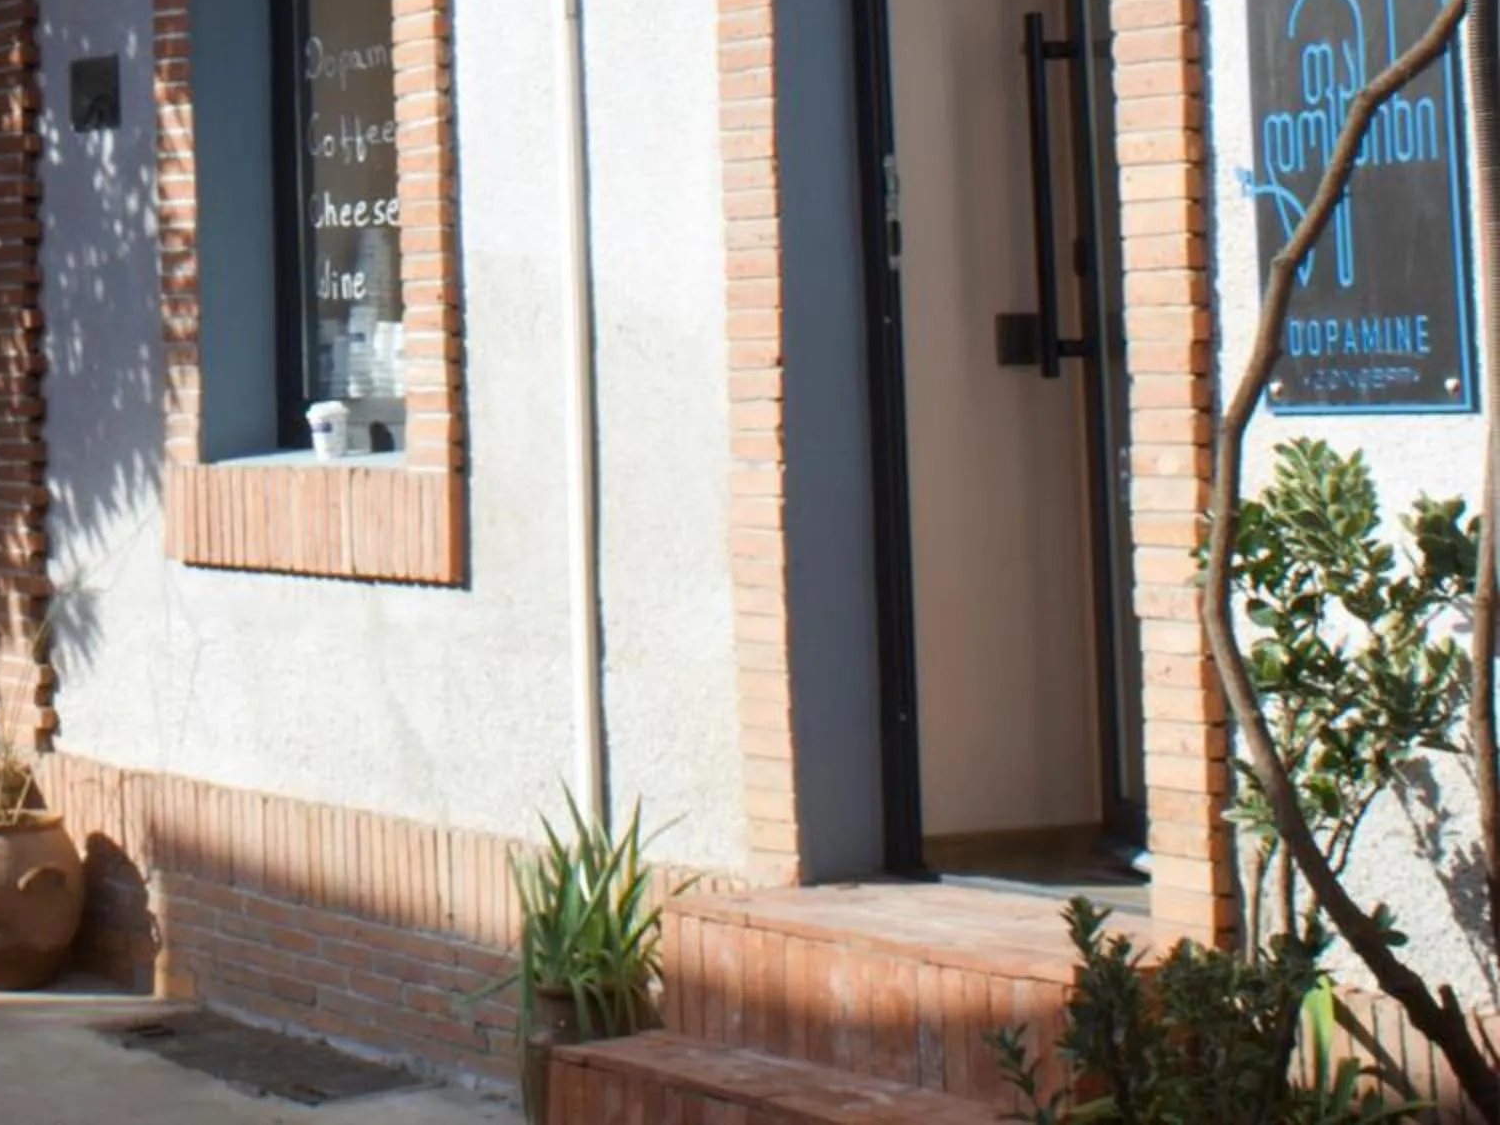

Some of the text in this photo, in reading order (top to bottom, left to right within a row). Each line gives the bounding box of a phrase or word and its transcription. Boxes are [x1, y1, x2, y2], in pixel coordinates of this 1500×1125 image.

[304, 36, 389, 91] Dopam
[306, 111, 395, 164] Coffee
[308, 191, 399, 228] Cheese
[1287, 314, 1431, 357] DOPAMINE
